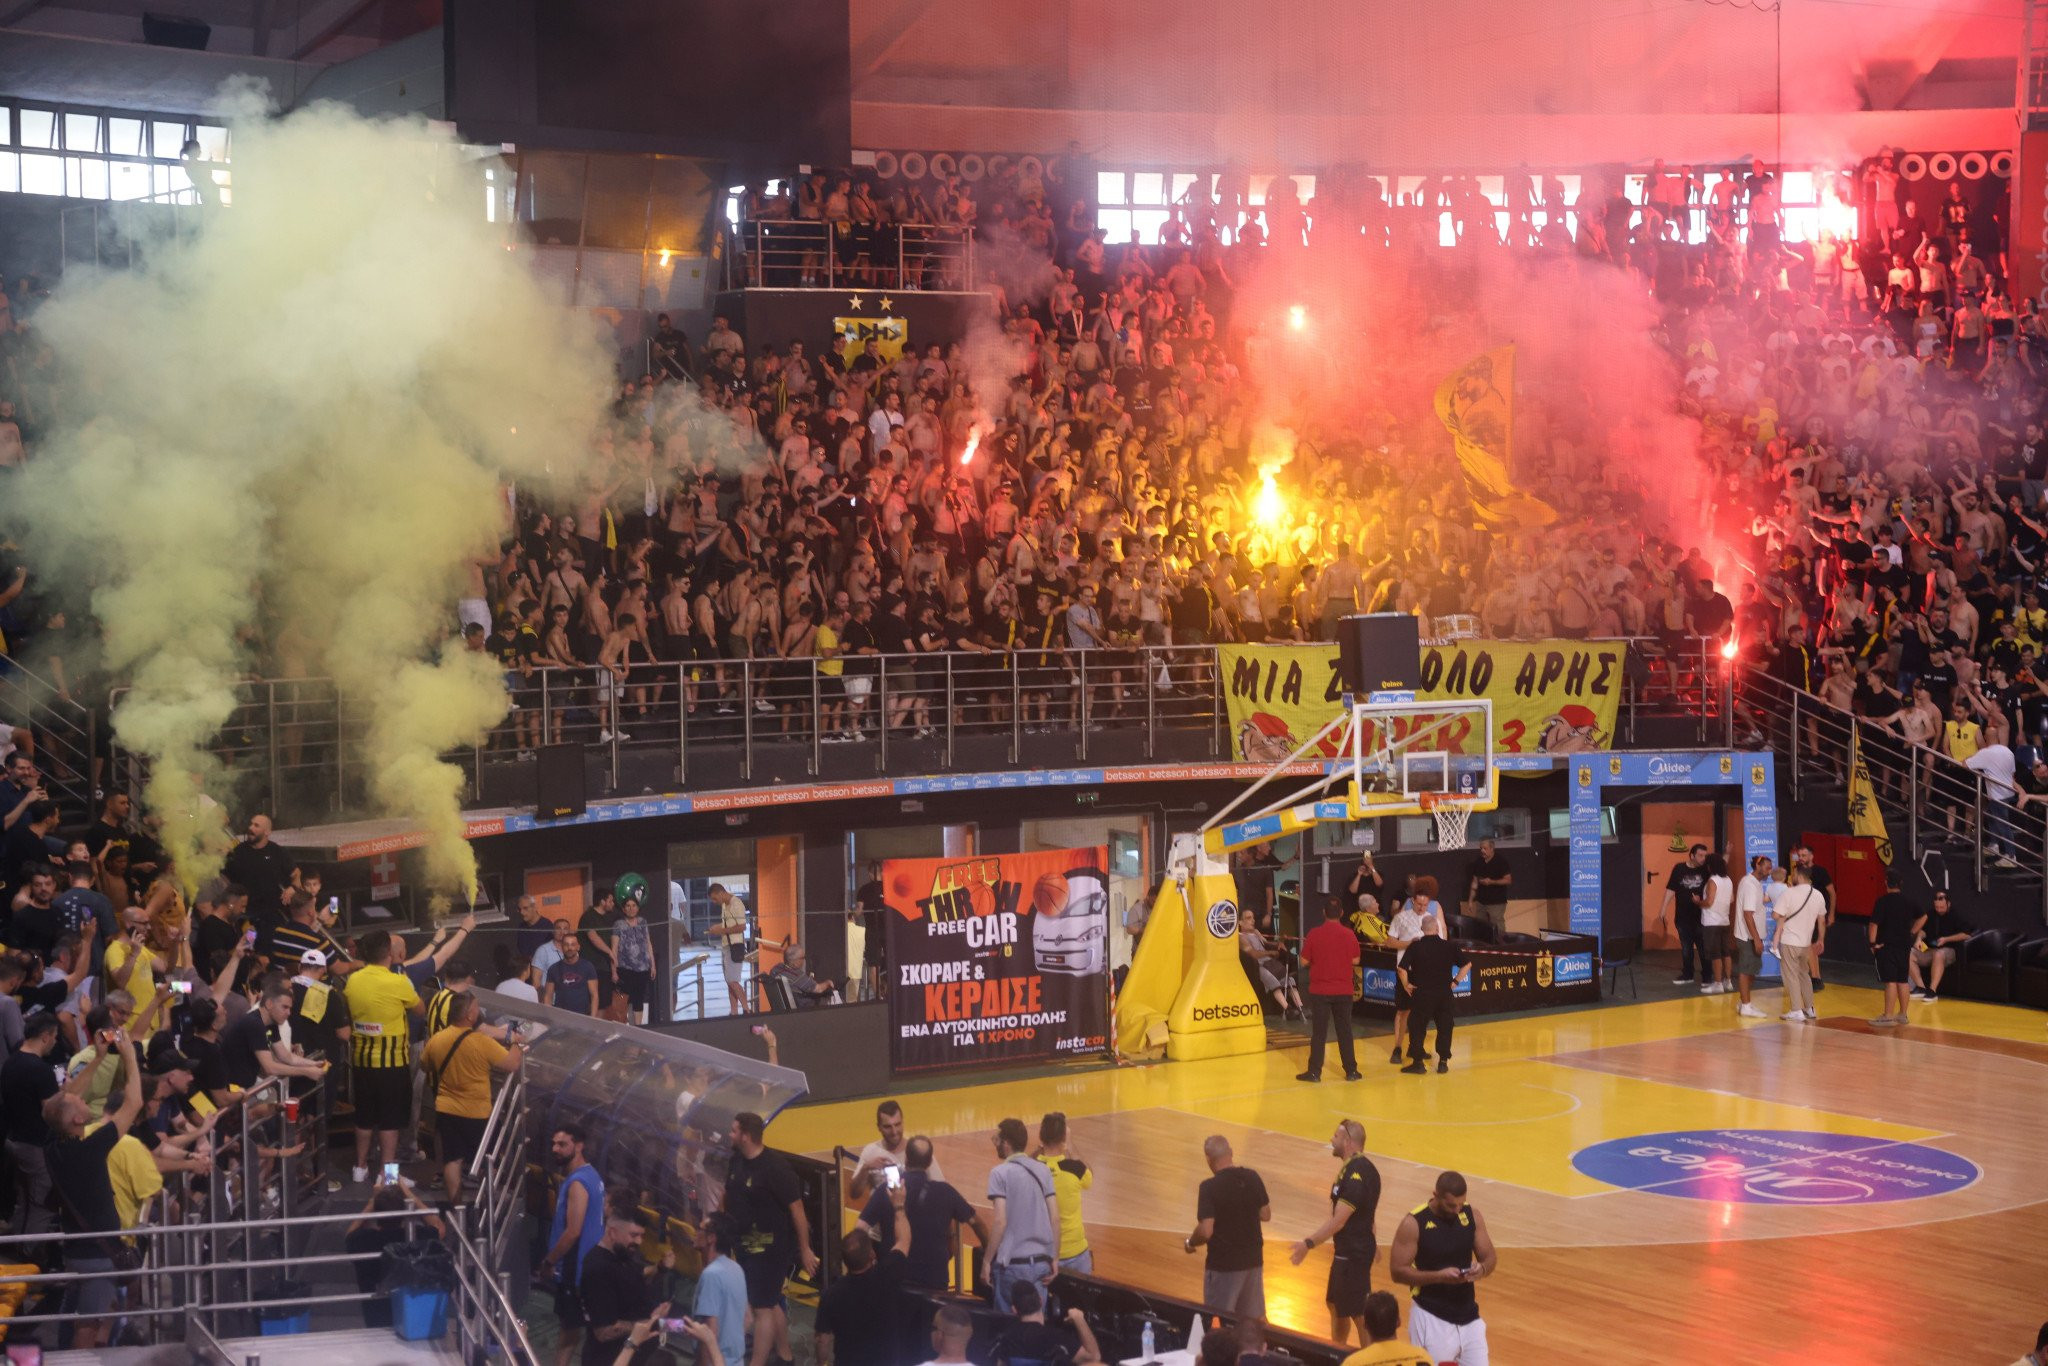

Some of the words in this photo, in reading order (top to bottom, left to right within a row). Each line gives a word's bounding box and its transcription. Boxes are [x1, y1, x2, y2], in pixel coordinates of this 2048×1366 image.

[1232, 656, 1302, 705] ΜΙΑ
[1515, 652, 1617, 697] ΑΡΗΣ
[1499, 719, 1526, 752] 3
[1107, 770, 1144, 780] betsson
[1150, 769, 1188, 779] betsson
[1192, 767, 1230, 777] betsson
[1651, 759, 1691, 774] Midea
[693, 798, 730, 809] betsson
[734, 795, 771, 806] betsson
[773, 792, 809, 803] betsson
[812, 788, 850, 799] betsson
[852, 785, 889, 795] betsson
[1575, 805, 1597, 814] Midea
[1748, 804, 1772, 812] Midea
[470, 823, 501, 834] betsson
[1241, 825, 1261, 835] Midea
[1575, 838, 1598, 847] Midea
[1750, 837, 1774, 845] Midea
[939, 859, 1000, 890] FREE
[1575, 871, 1598, 880] Midea
[1575, 905, 1598, 914] Midea
[928, 919, 966, 936] FREE
[966, 912, 1018, 948] CAR
[1480, 965, 1527, 977] HOSPITALITY
[1559, 959, 1590, 973] Midea
[901, 961, 970, 986] ΣΚΟΡΑΡΕ
[974, 965, 985, 980] &
[1368, 971, 1396, 989] Mide
[1482, 978, 1527, 991] AREA
[925, 975, 1042, 1022] ΚΕΡΔΙΣΕ
[1193, 1003, 1259, 1021] betsson
[901, 1023, 930, 1038] ΕΝΑ
[932, 1015, 1018, 1035] ΑΥΤΟΚΙΝΗΤΟ
[1021, 1010, 1067, 1027] ΠΟΛΗΣ
[954, 1033, 974, 1046] ΓΙΑ
[977, 1032, 985, 1044] 1
[988, 1029, 1036, 1042] ΧΡΟΝΟ
[1056, 1036, 1105, 1050] instacar
[1629, 1147, 1842, 1197] Midea
